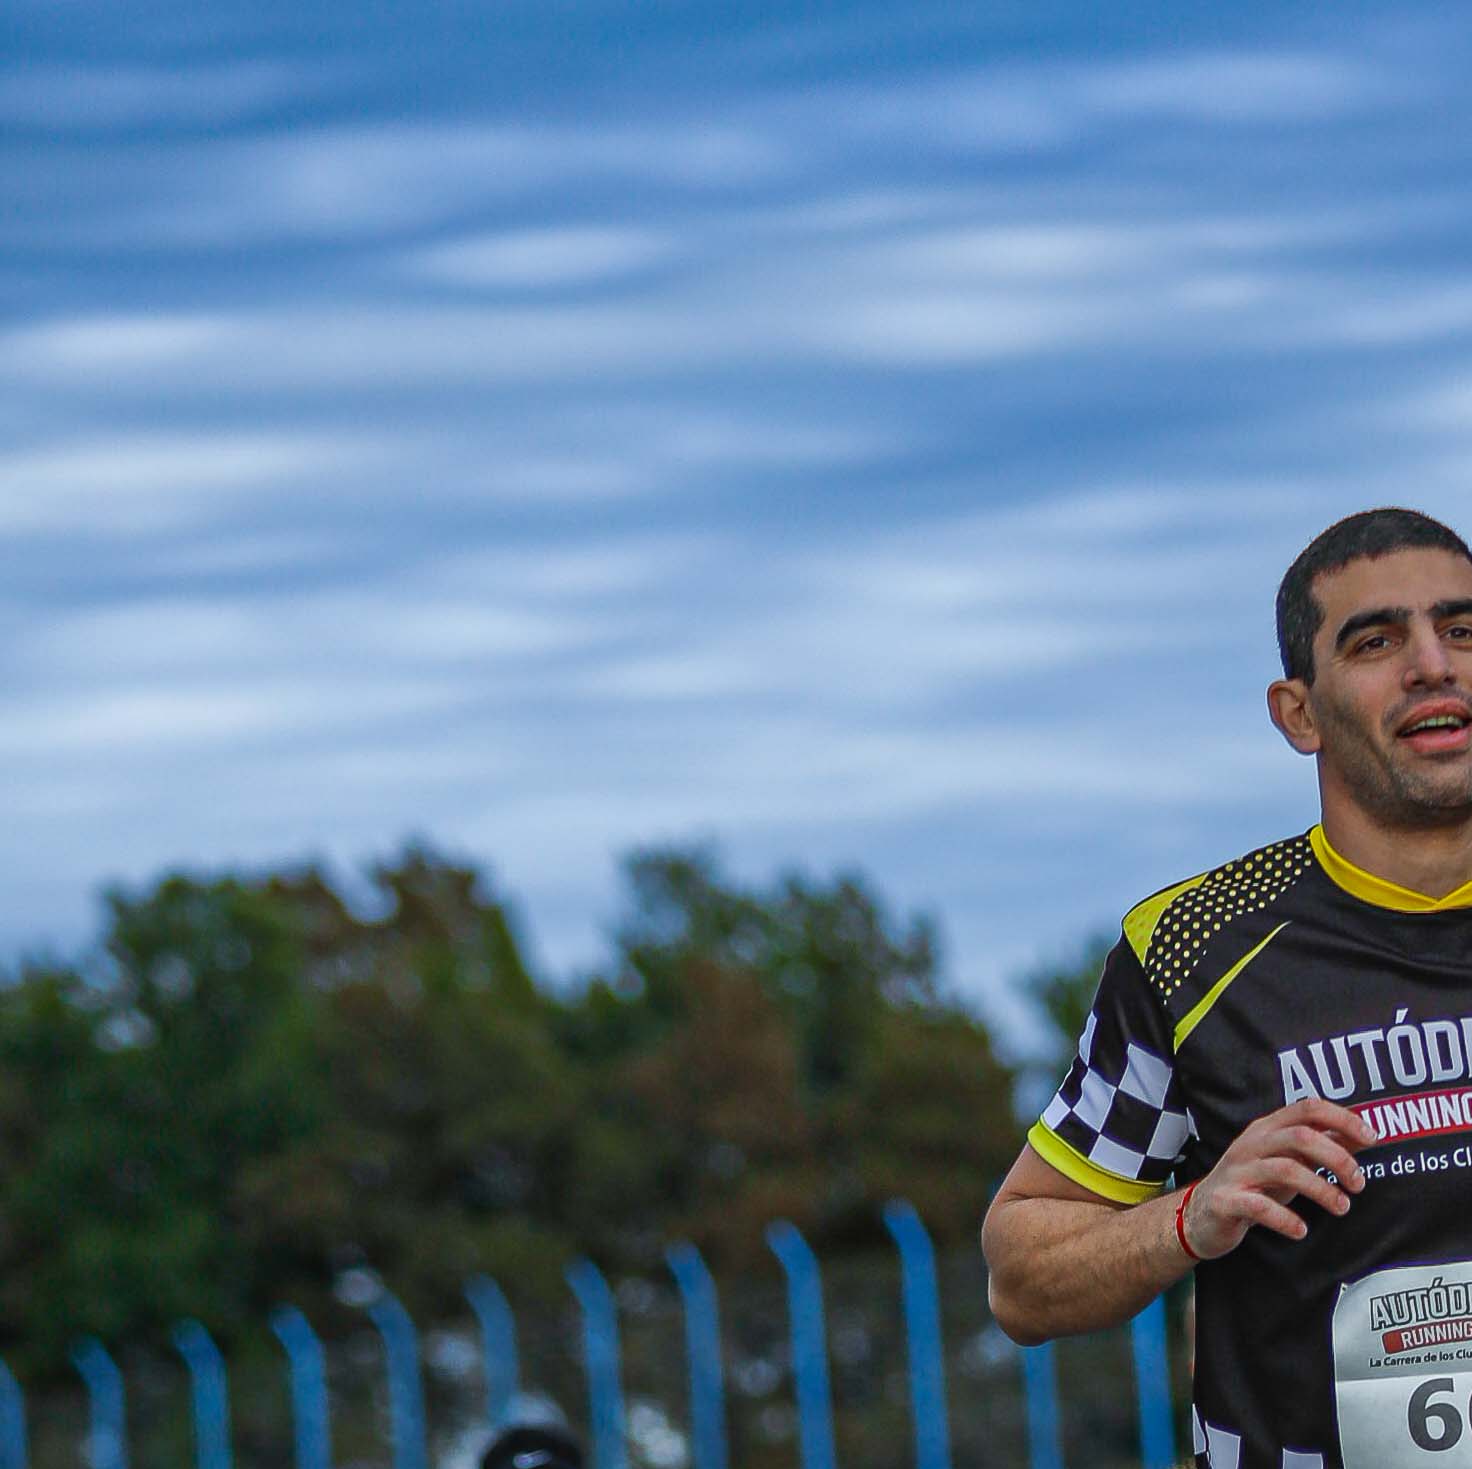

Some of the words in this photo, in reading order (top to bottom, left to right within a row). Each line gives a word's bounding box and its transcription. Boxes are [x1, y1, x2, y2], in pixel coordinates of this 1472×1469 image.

[1391, 1154, 1415, 1175] de
[1420, 1151, 1449, 1172] los
[1370, 1357, 1381, 1368] La
[1384, 1355, 1421, 1367] Carrera
[1424, 1352, 1437, 1362] de
[1439, 1351, 1454, 1361] los
